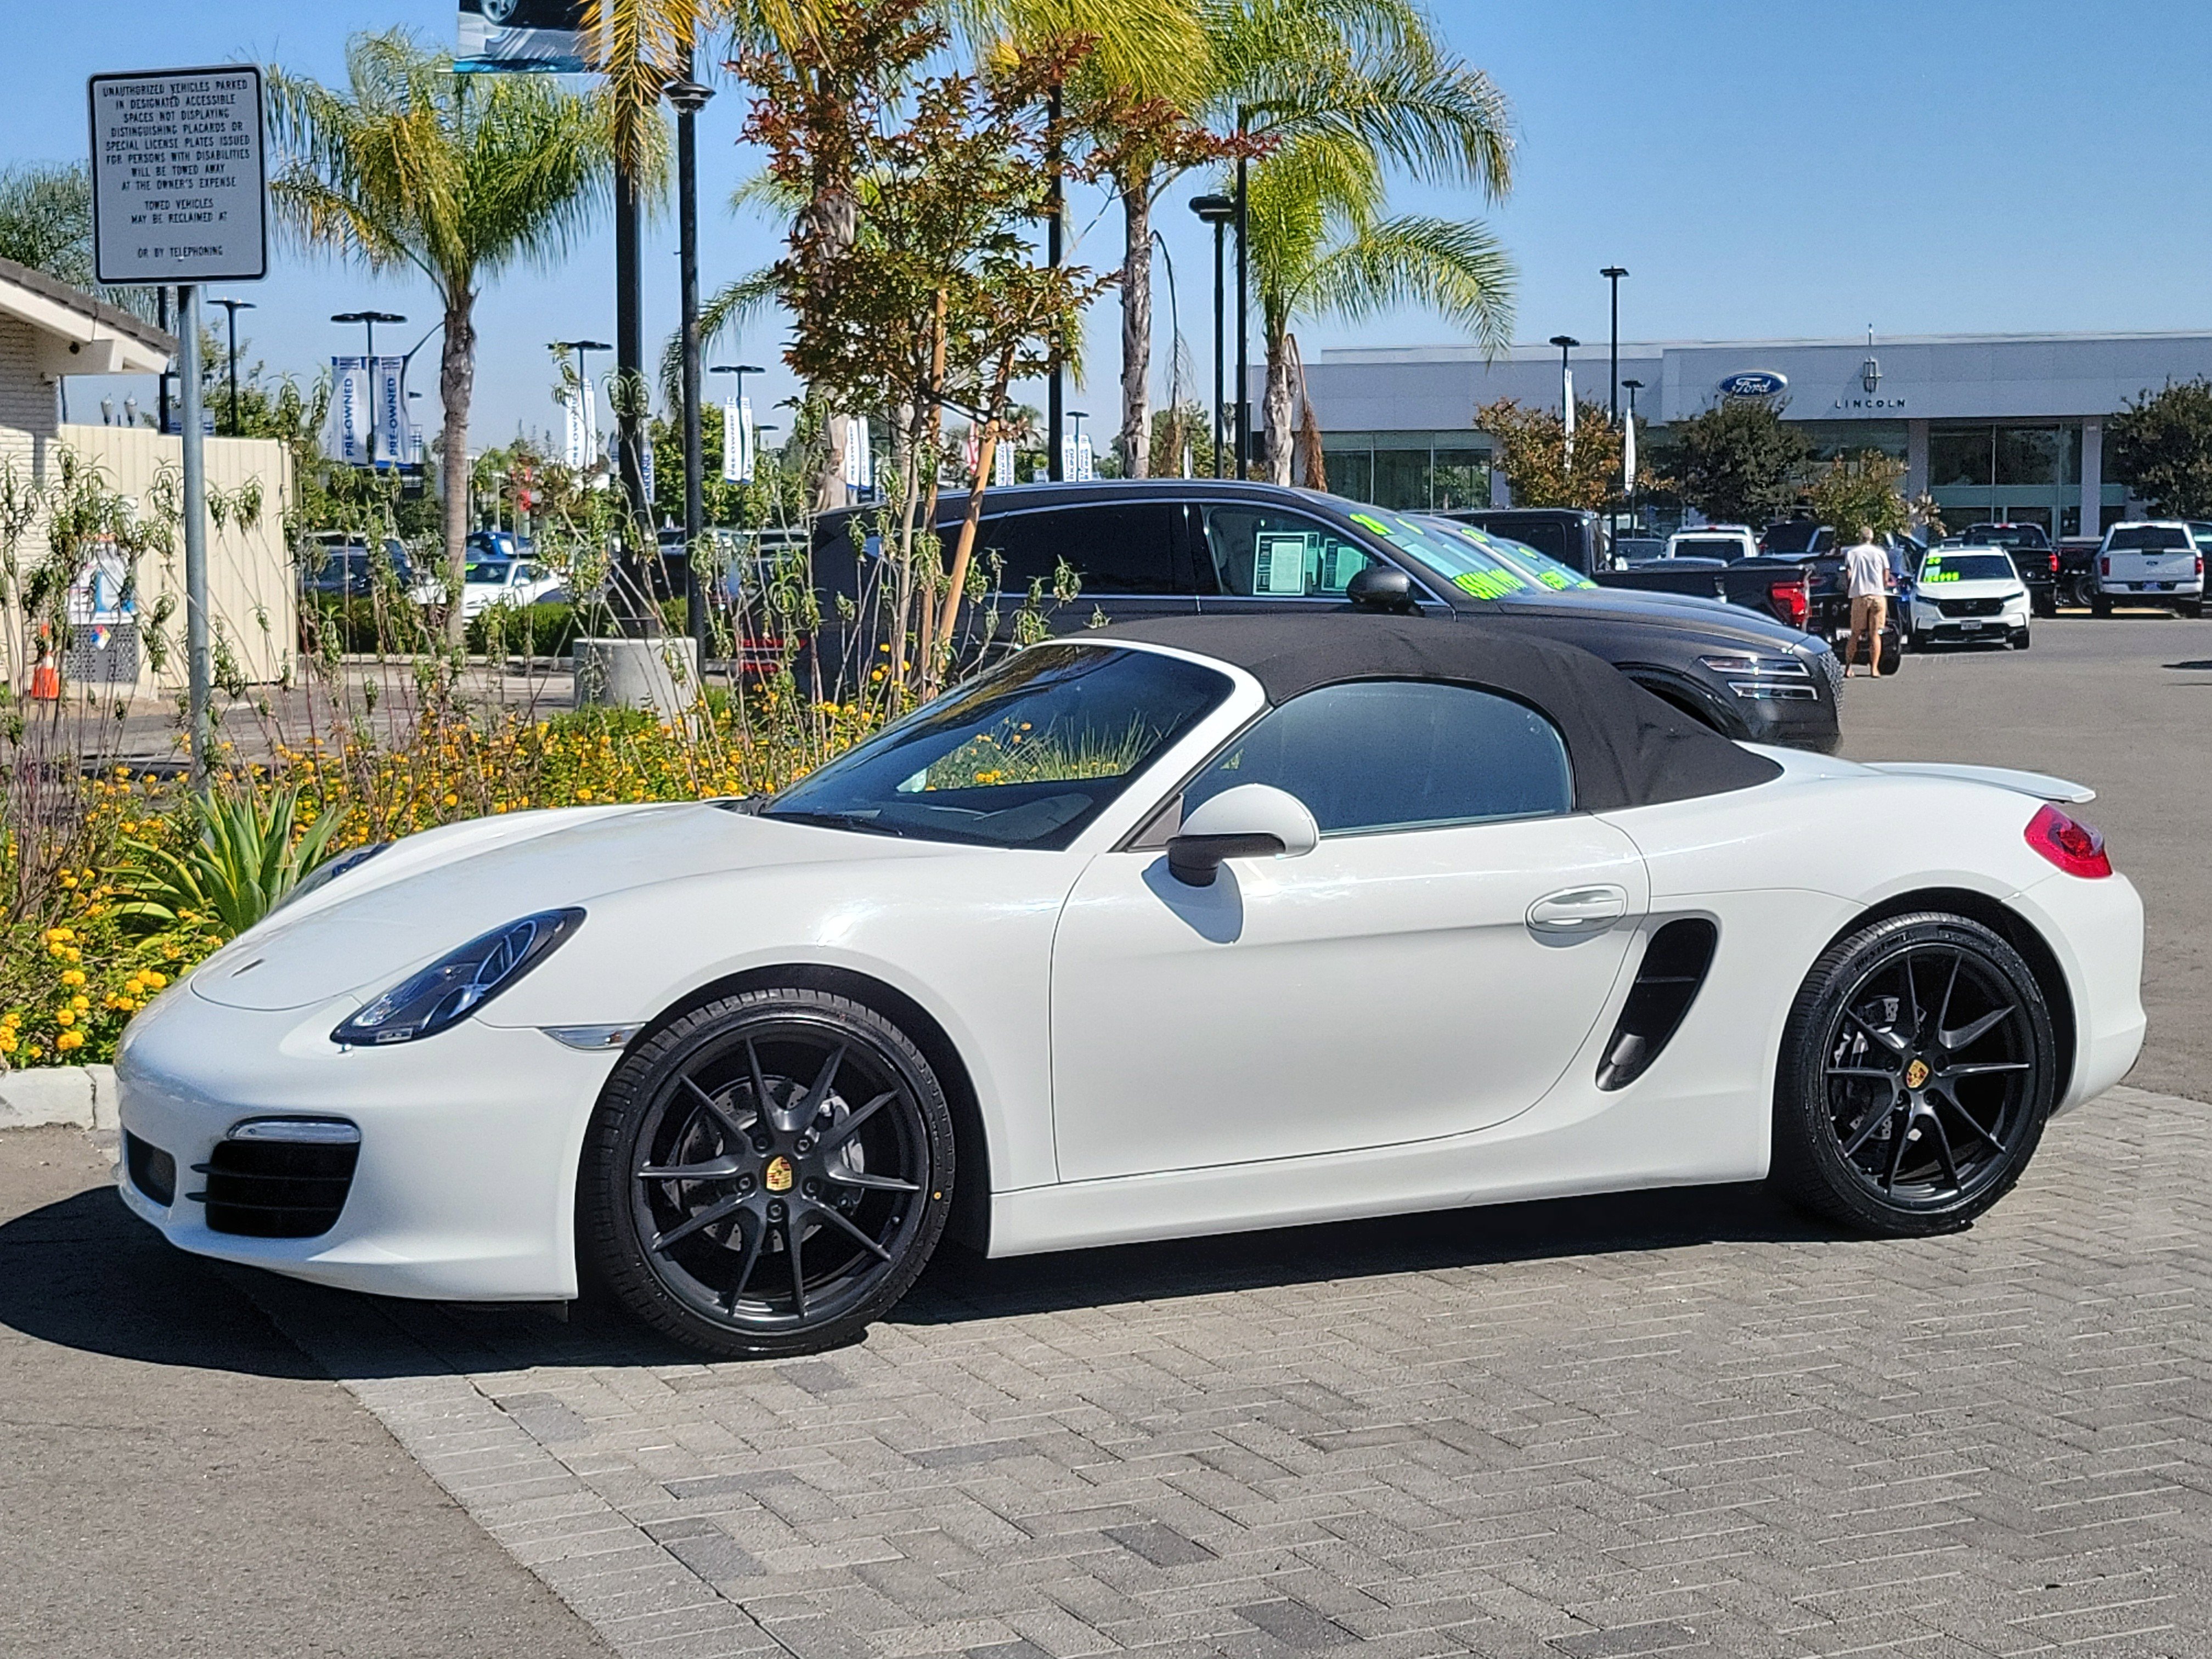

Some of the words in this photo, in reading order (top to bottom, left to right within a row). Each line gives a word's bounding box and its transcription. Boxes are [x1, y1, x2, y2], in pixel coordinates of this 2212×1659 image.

[103, 86, 165, 97] UNAUTHORIZED
[171, 82, 210, 93] VEHICLES
[216, 80, 247, 90] PARKED
[116, 100, 124, 109] IN
[131, 97, 179, 108] DESIGNATED
[185, 94, 236, 105] ACCESSIBLE
[124, 112, 153, 122] SPACES
[160, 112, 175, 121] NOT
[181, 109, 229, 120] DISPLAYING
[111, 126, 177, 137] DISTINGUISHING
[183, 124, 226, 133] PLACARDS
[232, 122, 242, 131] OR
[106, 141, 138, 151] SPECIAL
[145, 139, 178, 149] LICENSE
[185, 137, 214, 147] PLATES
[220, 136, 250, 145] ISSUED
[107, 155, 122, 165] FOR
[128, 154, 165, 163] PERSONS
[171, 152, 190, 161] WITH
[196, 149, 250, 160] DISABILITIES
[132, 168, 150, 177] WILL
[156, 167, 166, 176] BE
[173, 166, 199, 174] TOWED
[205, 164, 225, 173] AWAY
[122, 182, 130, 190] AT
[136, 180, 151, 190] THE
[157, 179, 193, 189] OWNER'S
[200, 177, 236, 187] EXPENSE
[145, 200, 170, 210] TOWED
[176, 198, 213, 208] VEHICLES
[132, 216, 146, 224] MAY
[153, 215, 162, 223] BE
[169, 212, 213, 223] RECLAIMED
[219, 212, 227, 220] AT
[138, 249, 148, 257] OR
[155, 247, 163, 256] BY
[170, 246, 223, 256] TELEPHONING
[1731, 377, 1771, 393] Ford
[1835, 399, 1905, 409] LINCOLN
[343, 379, 354, 456] PRE-OWNED
[387, 378, 398, 456] PRE-OWNED
